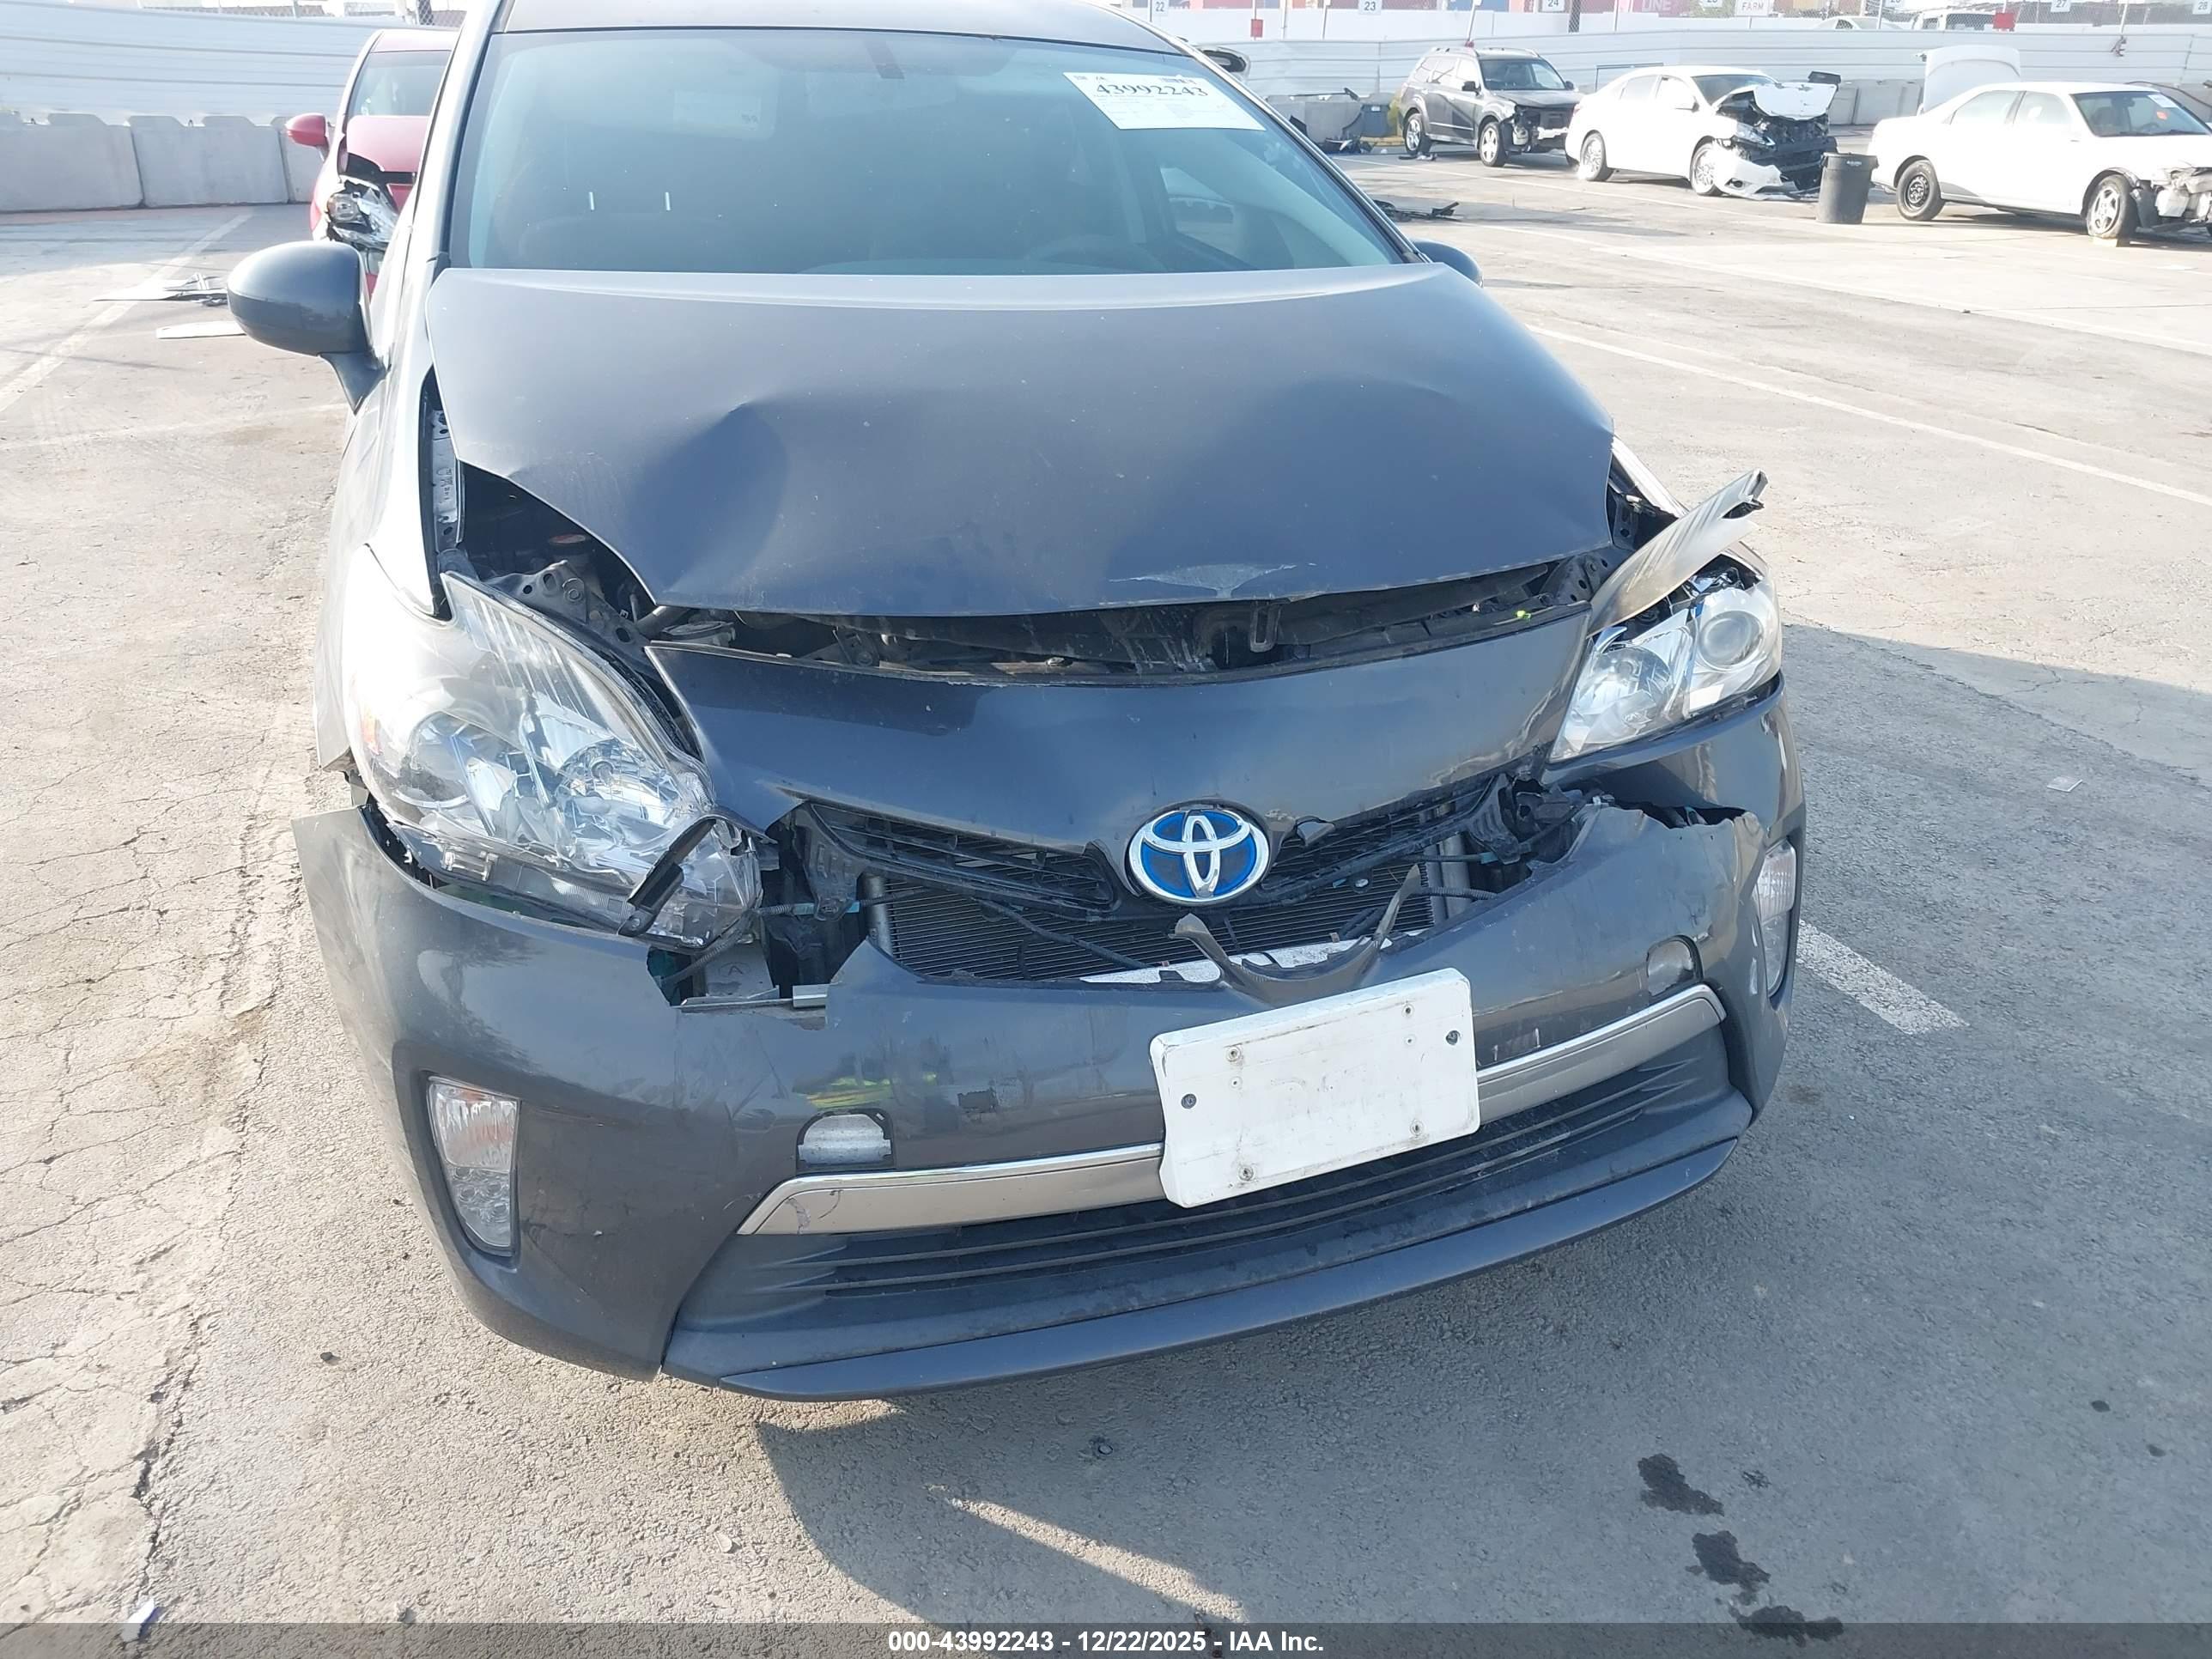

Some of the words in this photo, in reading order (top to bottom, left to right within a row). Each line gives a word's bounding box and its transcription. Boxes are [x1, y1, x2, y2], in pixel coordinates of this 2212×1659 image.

[1155, 2, 1165, 12] 22
[1364, 2, 1376, 11] 23
[2197, 2, 2209, 10] 28
[1097, 84, 1209, 96] 43992243
